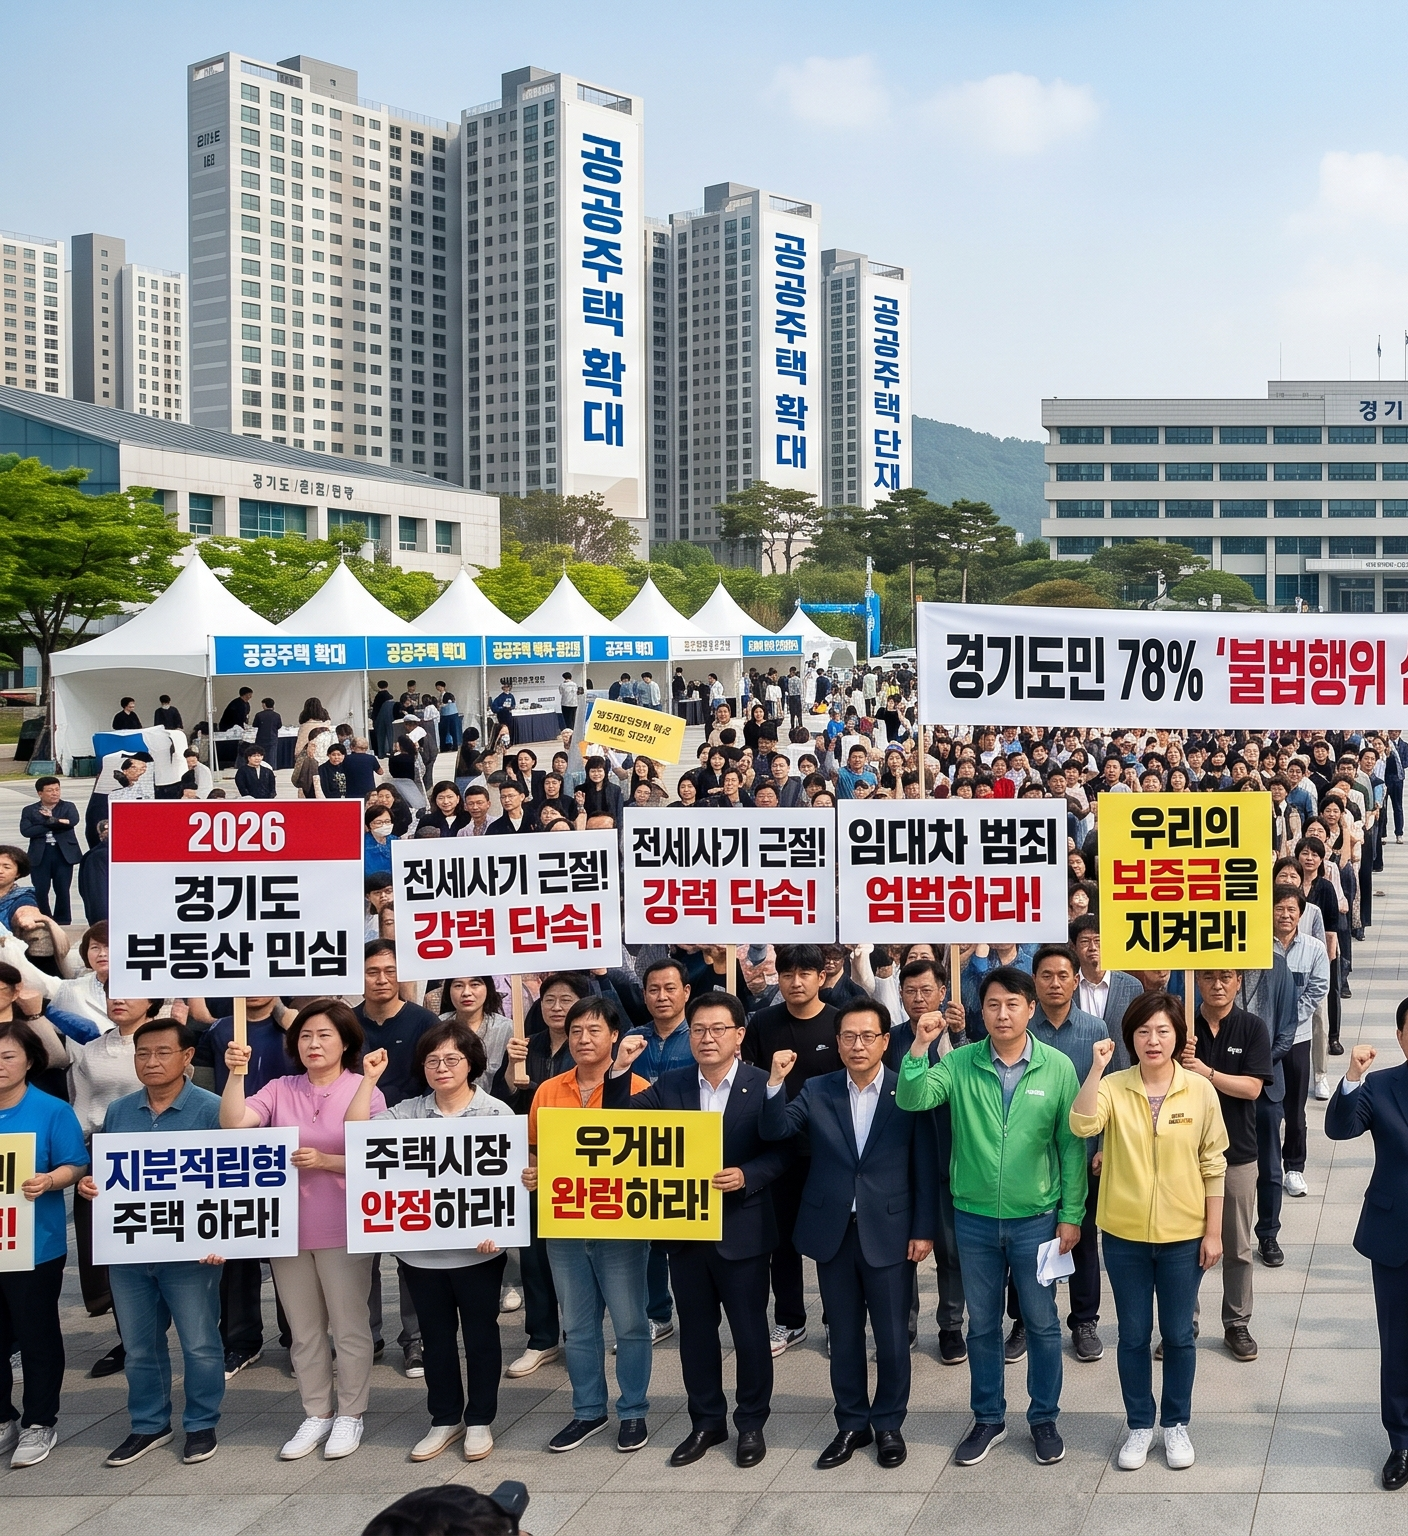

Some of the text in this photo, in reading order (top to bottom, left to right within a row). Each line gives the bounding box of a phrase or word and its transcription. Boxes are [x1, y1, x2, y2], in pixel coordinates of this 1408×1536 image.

[580, 133, 625, 448] 공공주택 확대
[775, 232, 808, 470] 공공주택 확대
[874, 295, 900, 424] 공공주택
[243, 643, 347, 668] 공공주택 확대
[946, 632, 1105, 701] 경기도민
[1117, 638, 1204, 702] 78%
[1216, 636, 1386, 706] '불법행위
[187, 810, 286, 853] 2026
[631, 826, 826, 868] 전세사기 근절!
[848, 817, 1057, 866] 임대차 범죄
[1130, 806, 1239, 850] 우리의
[174, 874, 300, 921] 경기도
[403, 849, 609, 901] 전세사기 근절!
[1112, 857, 1259, 902] 보증금을
[643, 877, 817, 924] 강력 단속!
[866, 877, 1041, 924] 엄벌하라!
[414, 902, 602, 960] 강력 단속!
[1125, 910, 1246, 955] 지켜라!
[125, 931, 347, 981] 부동산 민심
[105, 1144, 286, 1192] 지분적립형
[365, 1133, 510, 1180] 주택시장
[575, 1126, 684, 1167] 우거비
[112, 1197, 279, 1244] 주택 하라!
[360, 1186, 515, 1233] 안정하라!
[551, 1177, 709, 1221] 완렁하라!
